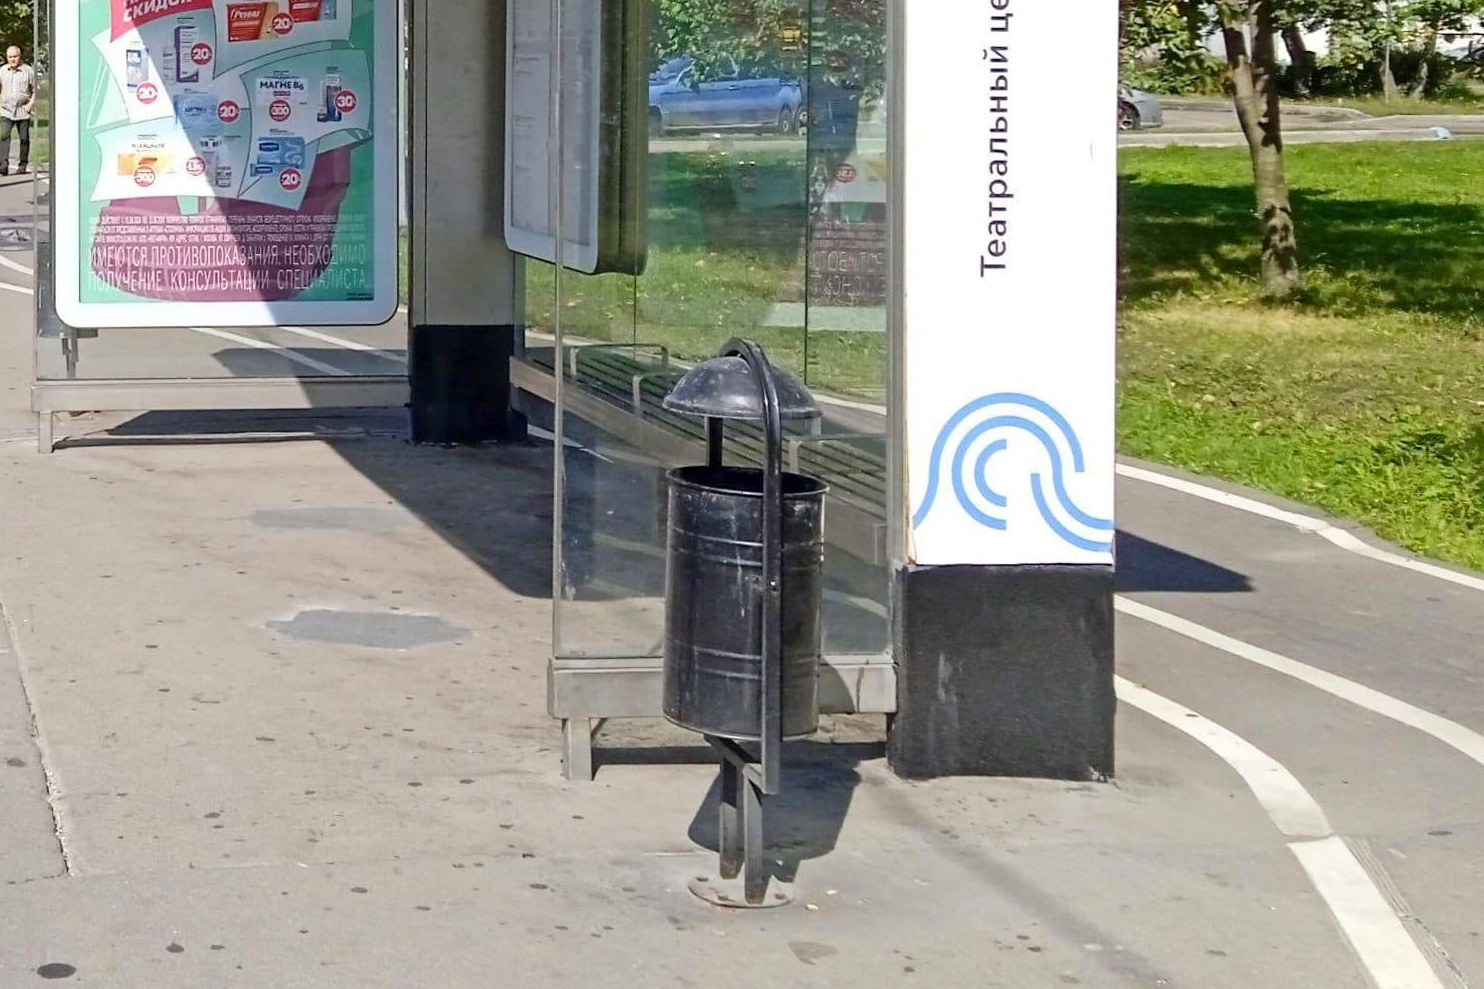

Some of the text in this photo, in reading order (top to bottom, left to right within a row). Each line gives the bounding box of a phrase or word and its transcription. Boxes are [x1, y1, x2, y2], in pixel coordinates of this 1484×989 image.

[259, 80, 292, 90] МАГНЕ
[980, 45, 1015, 278] Театральный
[90, 244, 365, 267] ИМЕЮТСЯ ПРОТИВОПОКАЗАНИЯ. НЕОБХОДИМО
[90, 269, 365, 293] ПОЛУЧЕНИЕ КОНСУЛЬТАЦИИ СПЕЦИАЛИСТА
